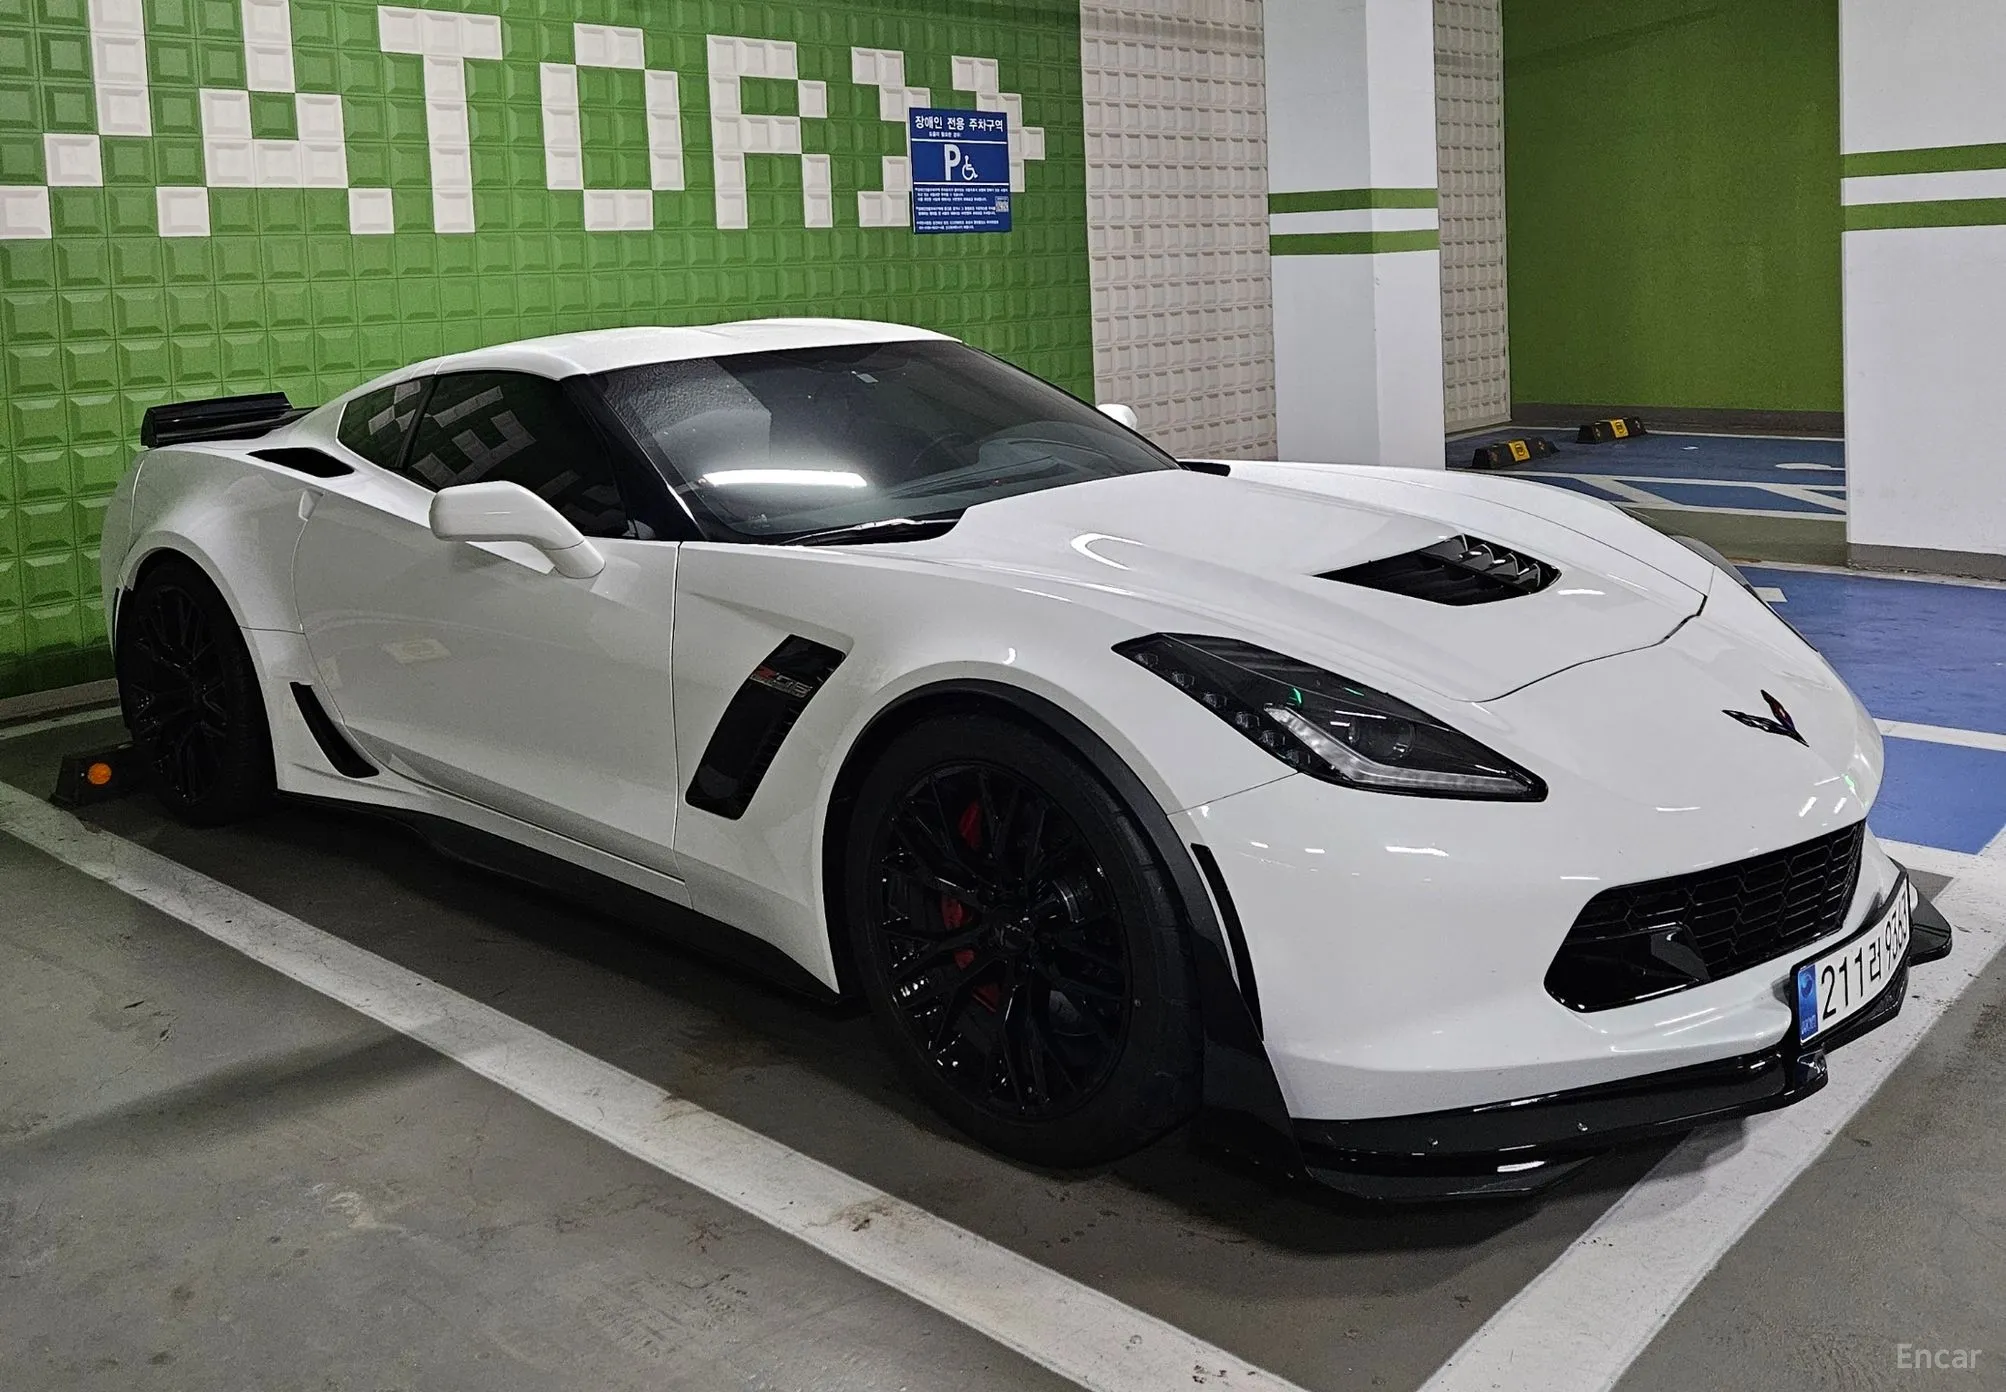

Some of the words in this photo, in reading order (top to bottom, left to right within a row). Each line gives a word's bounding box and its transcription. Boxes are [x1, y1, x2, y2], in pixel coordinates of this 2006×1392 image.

[915, 116, 943, 129] 장애인
[947, 117, 965, 131] 전용
[969, 118, 1004, 132] 주차구역
[944, 144, 961, 181] P
